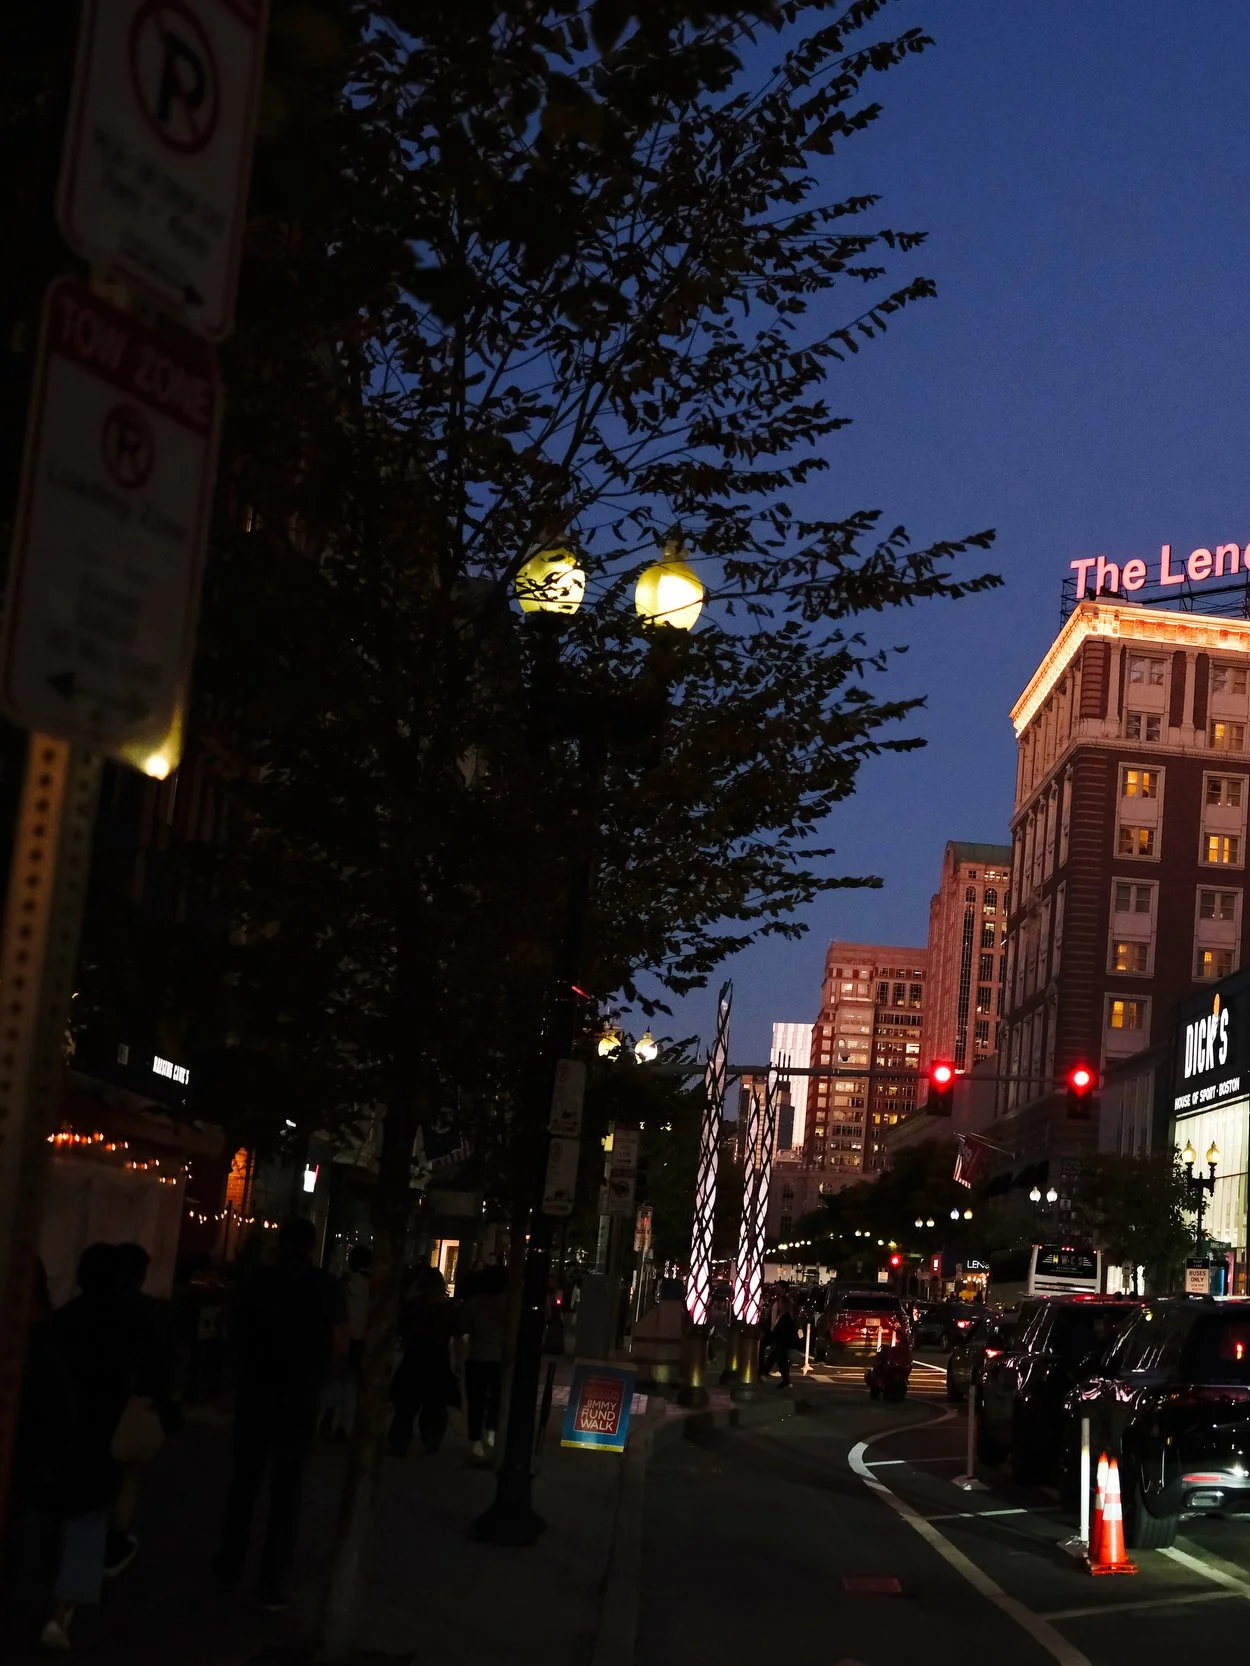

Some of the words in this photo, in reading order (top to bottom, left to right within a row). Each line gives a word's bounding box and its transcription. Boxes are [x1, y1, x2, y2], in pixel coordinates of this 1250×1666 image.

[1070, 555, 1147, 599] The
[1184, 992, 1230, 1079] DICK'S
[1174, 1093, 1191, 1111] HOUSE
[1192, 1090, 1200, 1105] OF
[1199, 1085, 1217, 1103] SPORT
[1218, 1076, 1241, 1097] BOSTON
[580, 1407, 616, 1421] FUND
[583, 1399, 618, 1411] JIMMY
[580, 1418, 613, 1431] WALK
